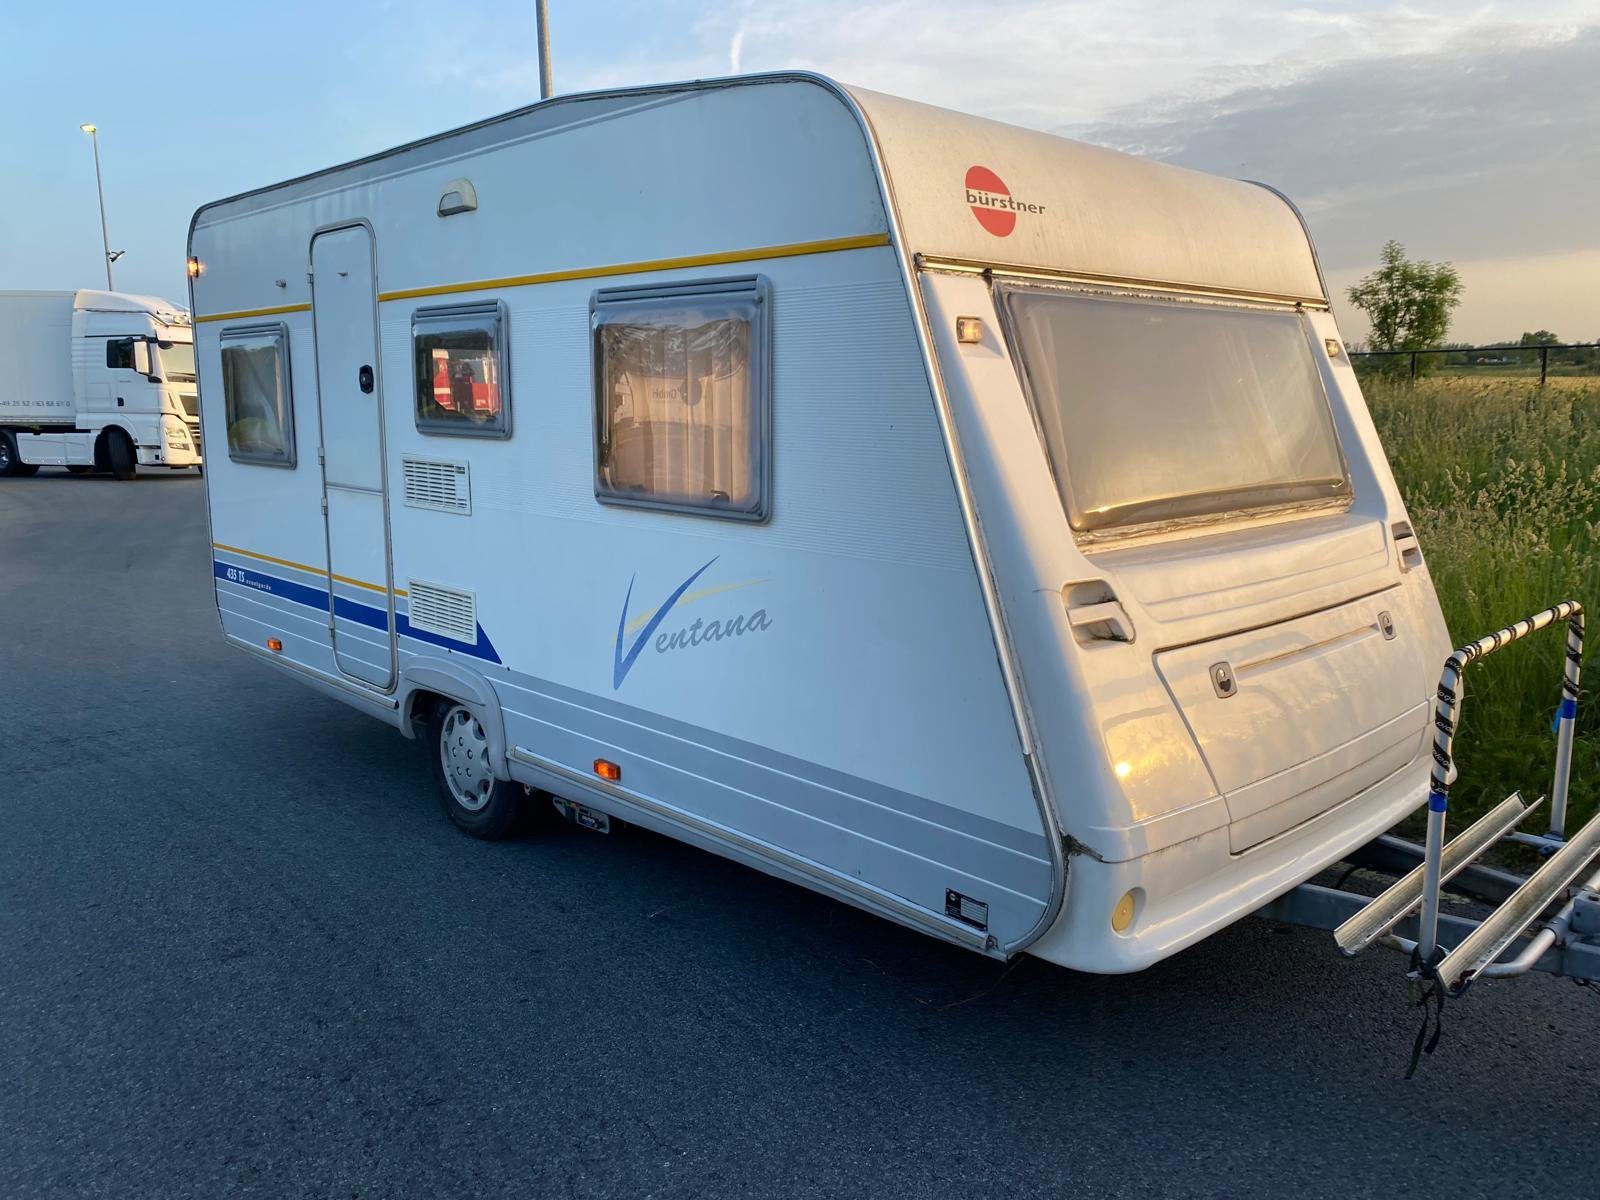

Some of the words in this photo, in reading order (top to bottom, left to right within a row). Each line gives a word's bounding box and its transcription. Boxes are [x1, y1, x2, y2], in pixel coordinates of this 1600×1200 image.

[965, 189, 1046, 215] bürstner
[227, 568, 237, 581] 435
[238, 570, 245, 582] TS
[613, 554, 773, 691] Ventana
